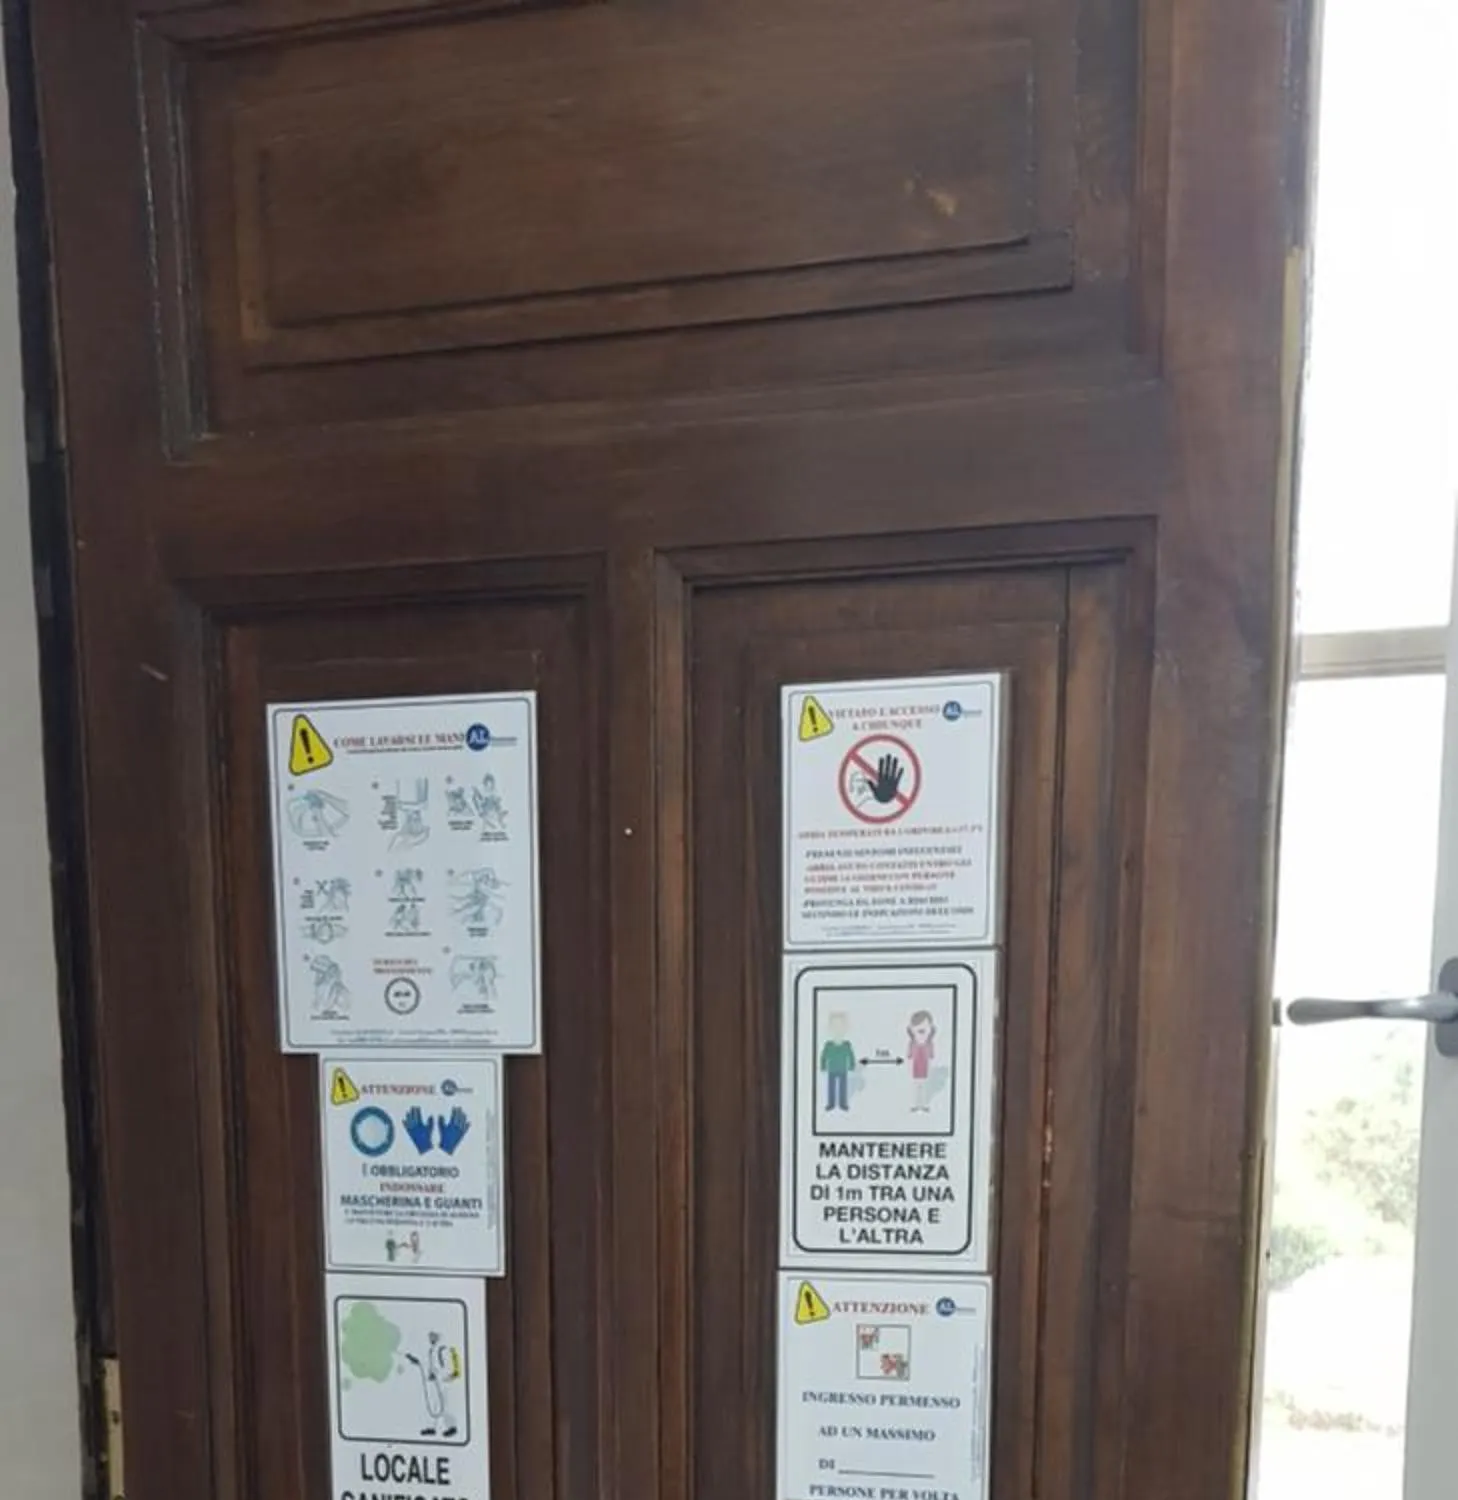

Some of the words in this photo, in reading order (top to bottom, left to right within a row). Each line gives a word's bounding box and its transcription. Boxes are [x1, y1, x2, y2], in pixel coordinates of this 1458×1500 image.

[829, 706, 877, 719] VIETATO
[862, 719, 922, 731] CHIUNQUE
[361, 1083, 436, 1096] ATTENZIONE
[819, 1142, 947, 1160] MANTENERE
[369, 1164, 460, 1178] OBBLIGATORIO
[816, 1164, 841, 1180] LA
[847, 1163, 949, 1180] DISTANZA
[380, 1183, 443, 1194] INDOSSARE
[811, 1185, 830, 1201] DI
[837, 1186, 863, 1201] 1m
[869, 1185, 907, 1201] TRA
[912, 1186, 955, 1202] UNA
[340, 1194, 421, 1208] MASCHERINA
[424, 1196, 432, 1208] E
[434, 1197, 483, 1210] GUANTI
[823, 1207, 921, 1223] PERSONA
[928, 1207, 940, 1223] E
[839, 1227, 924, 1245] L'ALTRA
[832, 1301, 929, 1315] ATTENZIONE
[802, 1391, 876, 1406] INGRESSO
[880, 1394, 961, 1409] PERMESSO
[818, 1426, 837, 1438] AD
[842, 1427, 863, 1439] UN
[866, 1428, 936, 1442] MASSIMO
[360, 1453, 451, 1485] LOCALE
[818, 1459, 835, 1470] DI
[809, 1484, 876, 1499] PERSONE
[880, 1487, 908, 1500] PER
